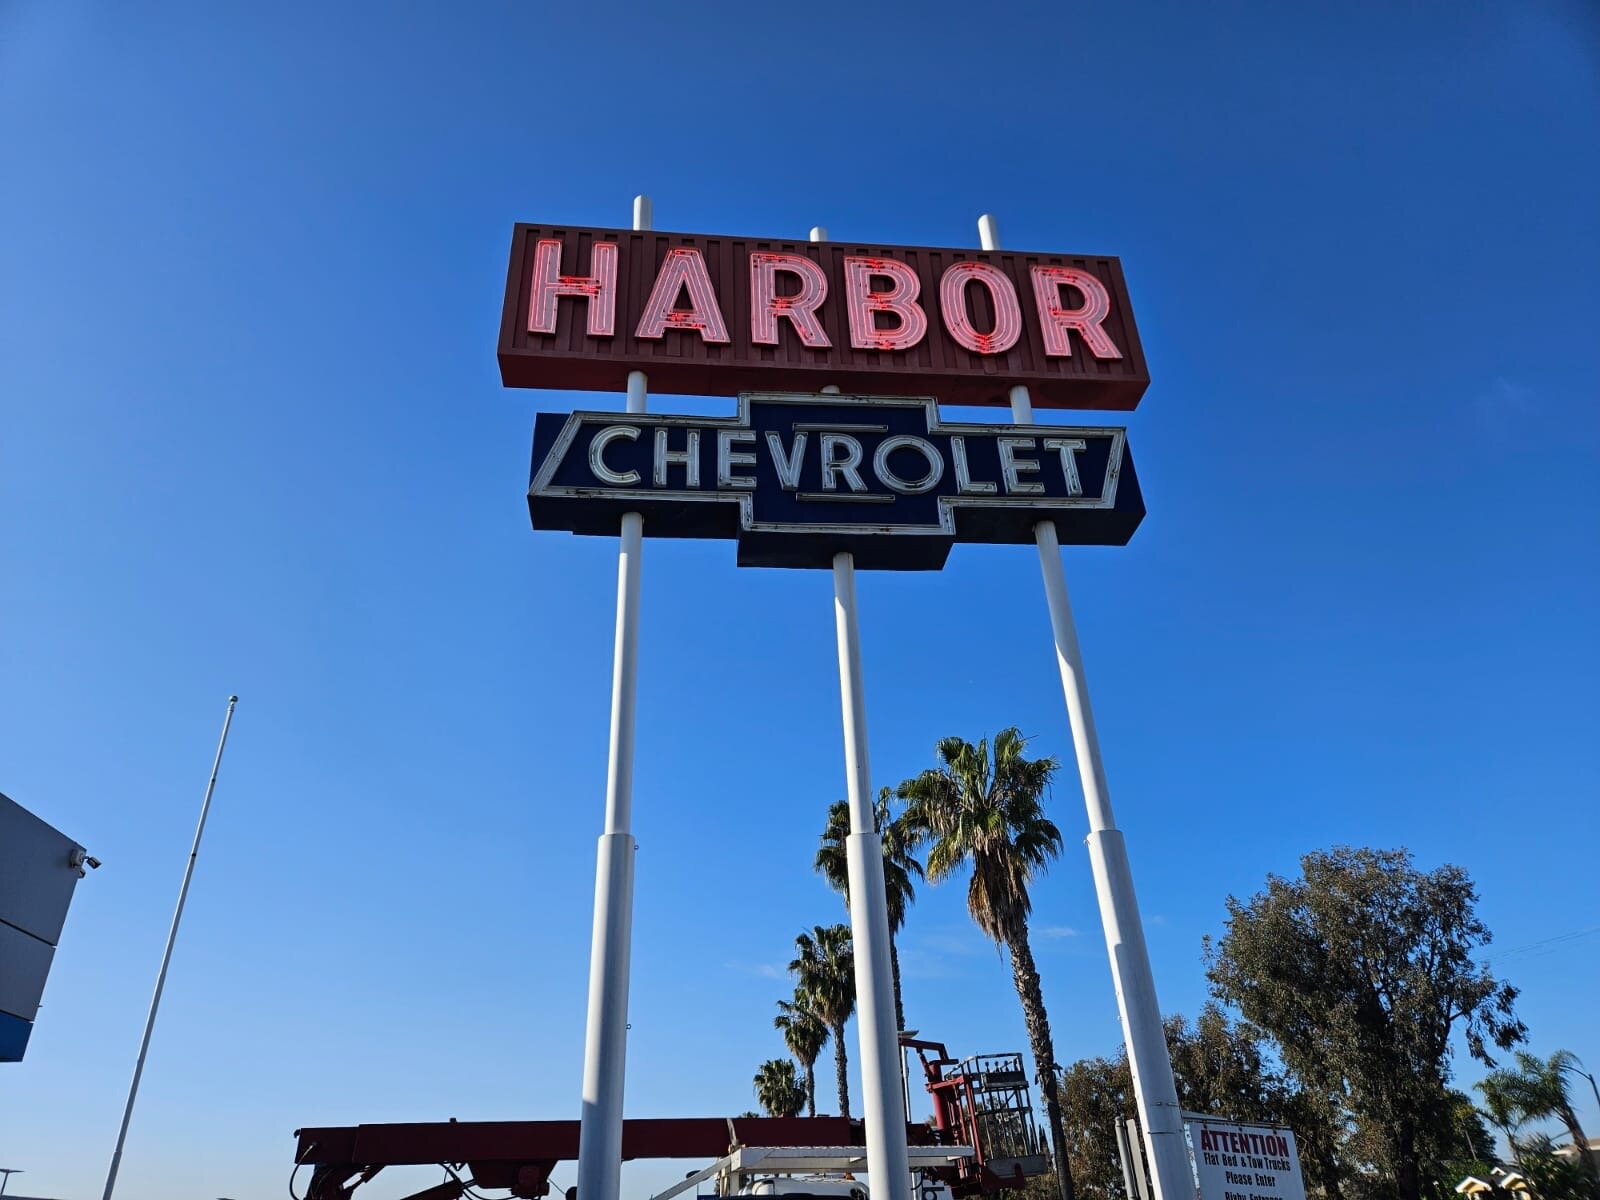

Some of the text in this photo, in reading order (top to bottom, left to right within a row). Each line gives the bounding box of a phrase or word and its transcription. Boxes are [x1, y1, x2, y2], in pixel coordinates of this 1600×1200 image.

[527, 240, 1122, 359] HARBOR
[588, 425, 1087, 496] CHEVROLET
[1201, 1130, 1290, 1157] ATTENTION
[1204, 1152, 1291, 1171] Flat Bed & Tow Trucks
[1225, 1171, 1276, 1187] Please Enter
